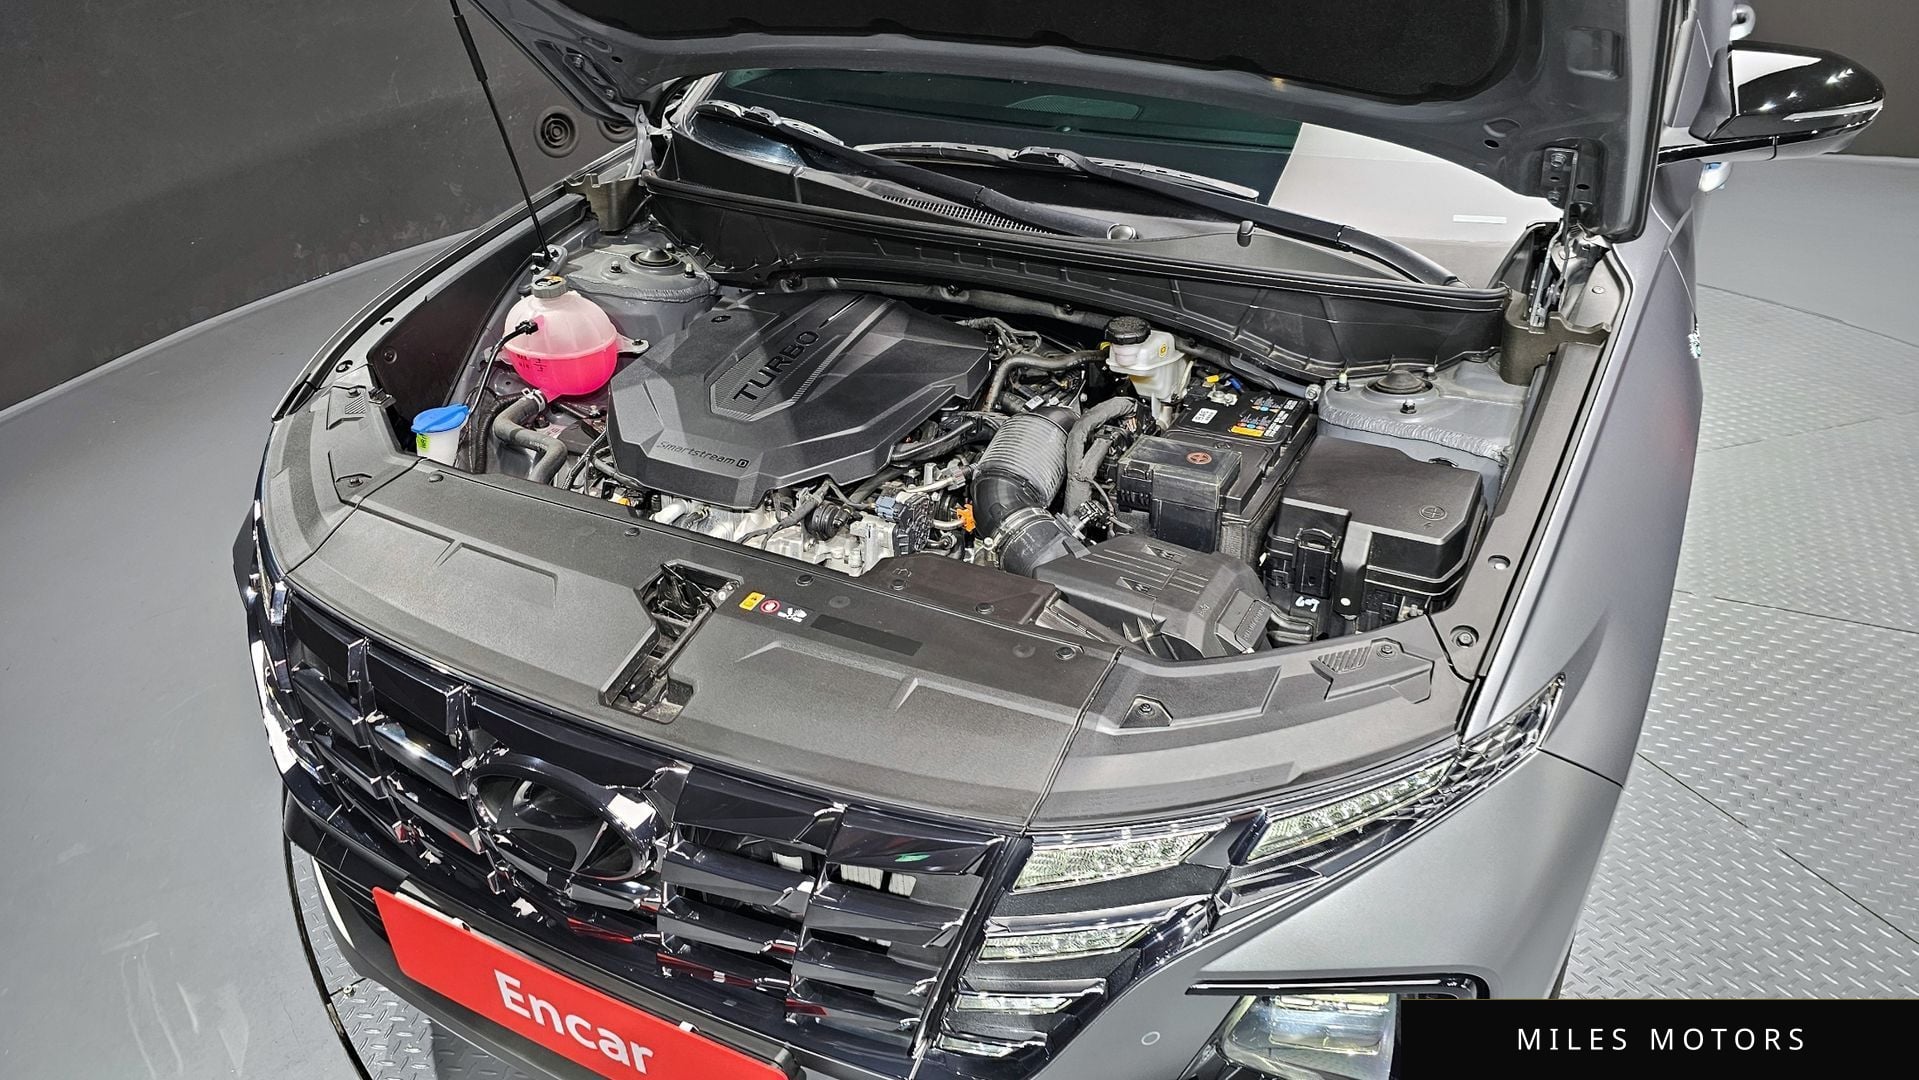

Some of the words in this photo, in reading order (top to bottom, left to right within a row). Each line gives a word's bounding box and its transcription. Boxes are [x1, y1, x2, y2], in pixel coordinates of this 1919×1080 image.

[732, 331, 820, 400] TURBO
[657, 441, 735, 465] Smartstream
[493, 968, 655, 1075] Encar
